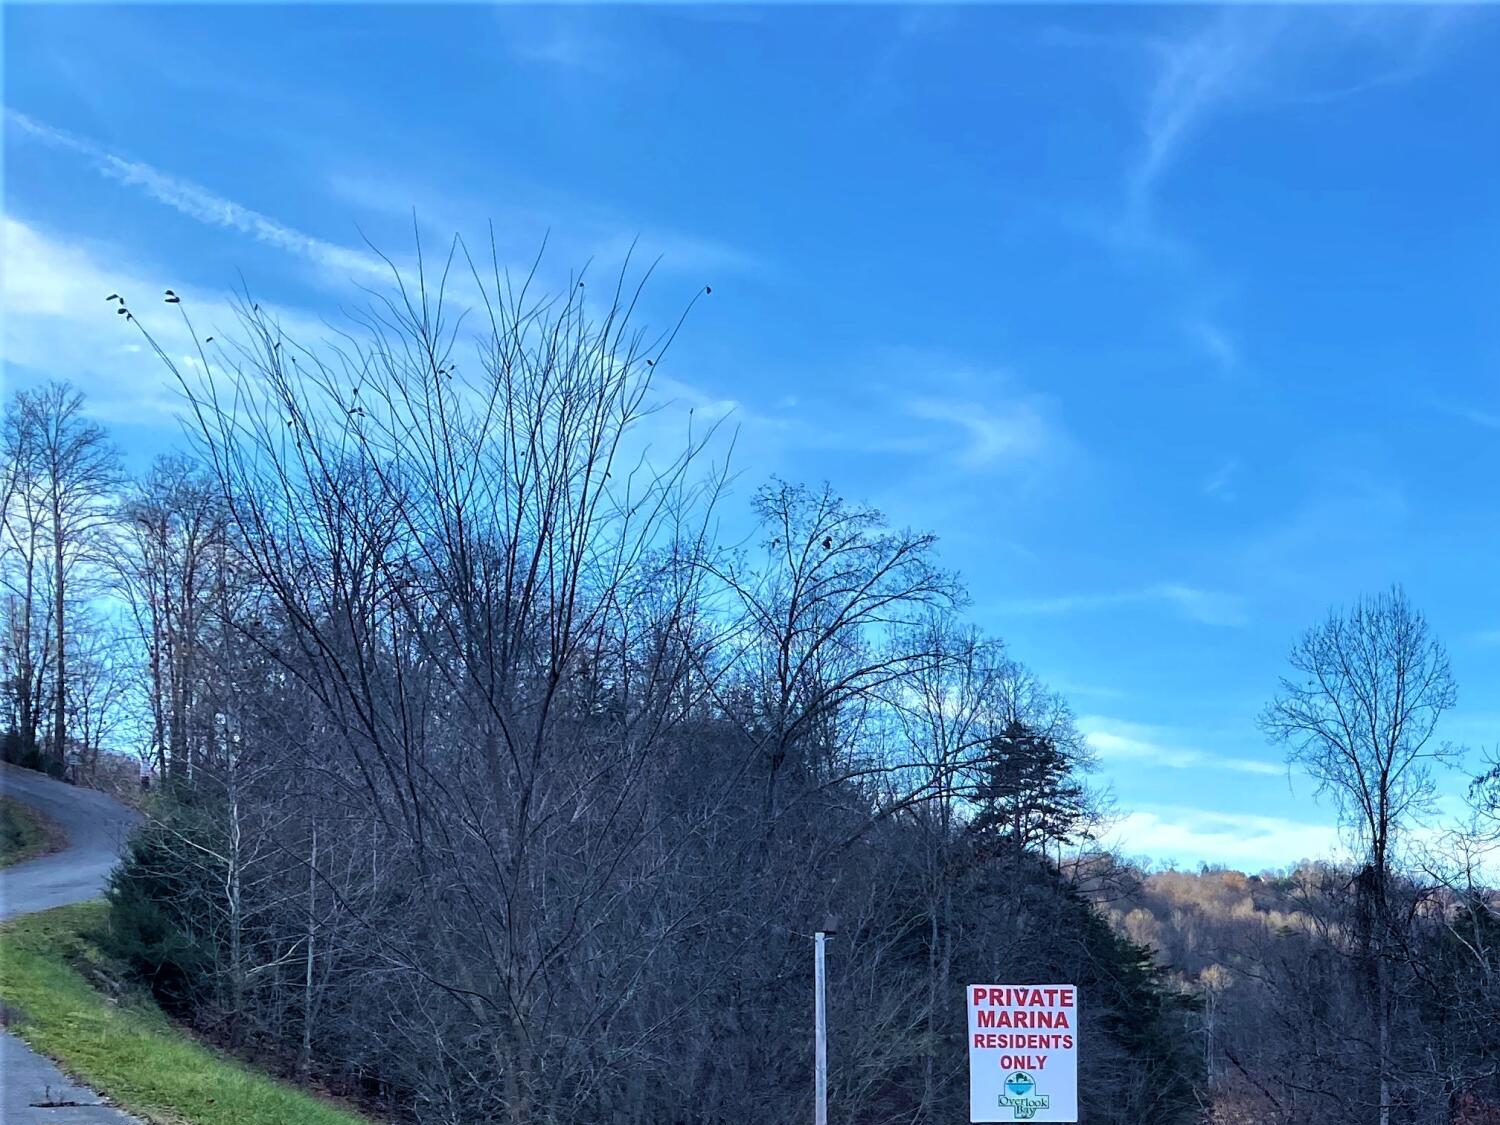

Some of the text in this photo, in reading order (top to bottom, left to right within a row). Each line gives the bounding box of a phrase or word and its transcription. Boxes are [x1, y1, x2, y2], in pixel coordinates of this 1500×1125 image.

[973, 988, 1073, 1007] PRIVATE
[977, 1010, 1069, 1028] MARINA
[974, 1034, 1073, 1049] RESIDENTS
[1001, 1055, 1047, 1070] ONLY
[999, 1096, 1047, 1107] Overlook
